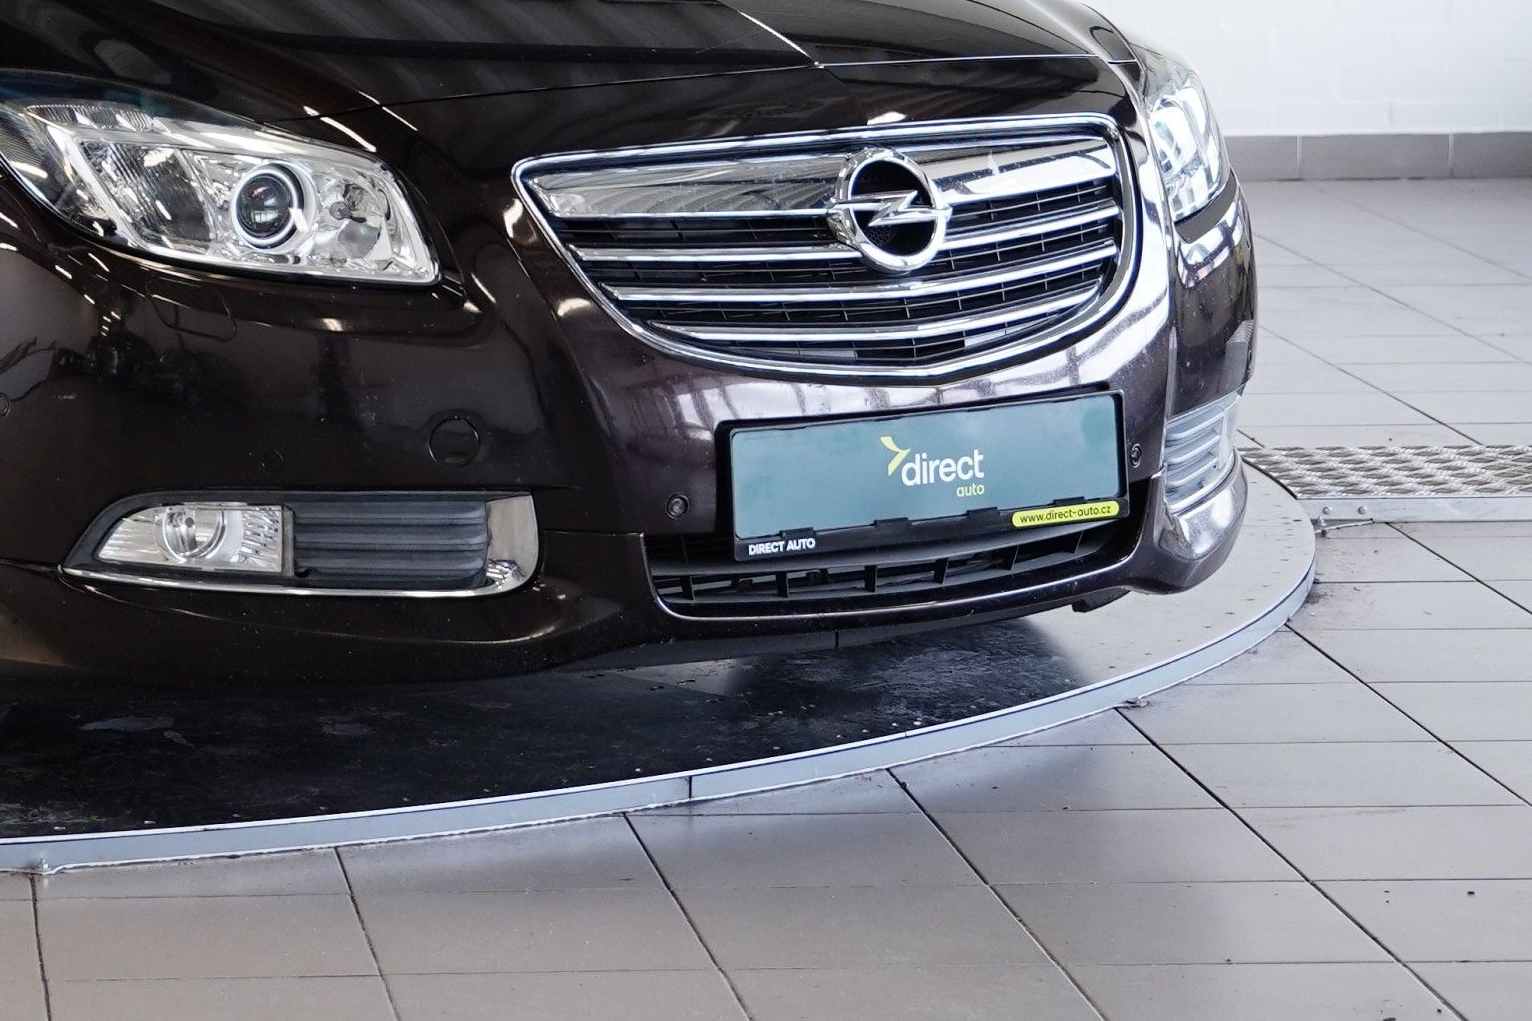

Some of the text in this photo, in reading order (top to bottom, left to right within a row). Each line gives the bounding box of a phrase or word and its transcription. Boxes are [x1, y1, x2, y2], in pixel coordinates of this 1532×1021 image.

[901, 449, 985, 486] direct
[955, 482, 985, 497] auto
[1019, 505, 1111, 524] www.direct-auto.cz
[748, 538, 816, 555] DIRECT AUTO
